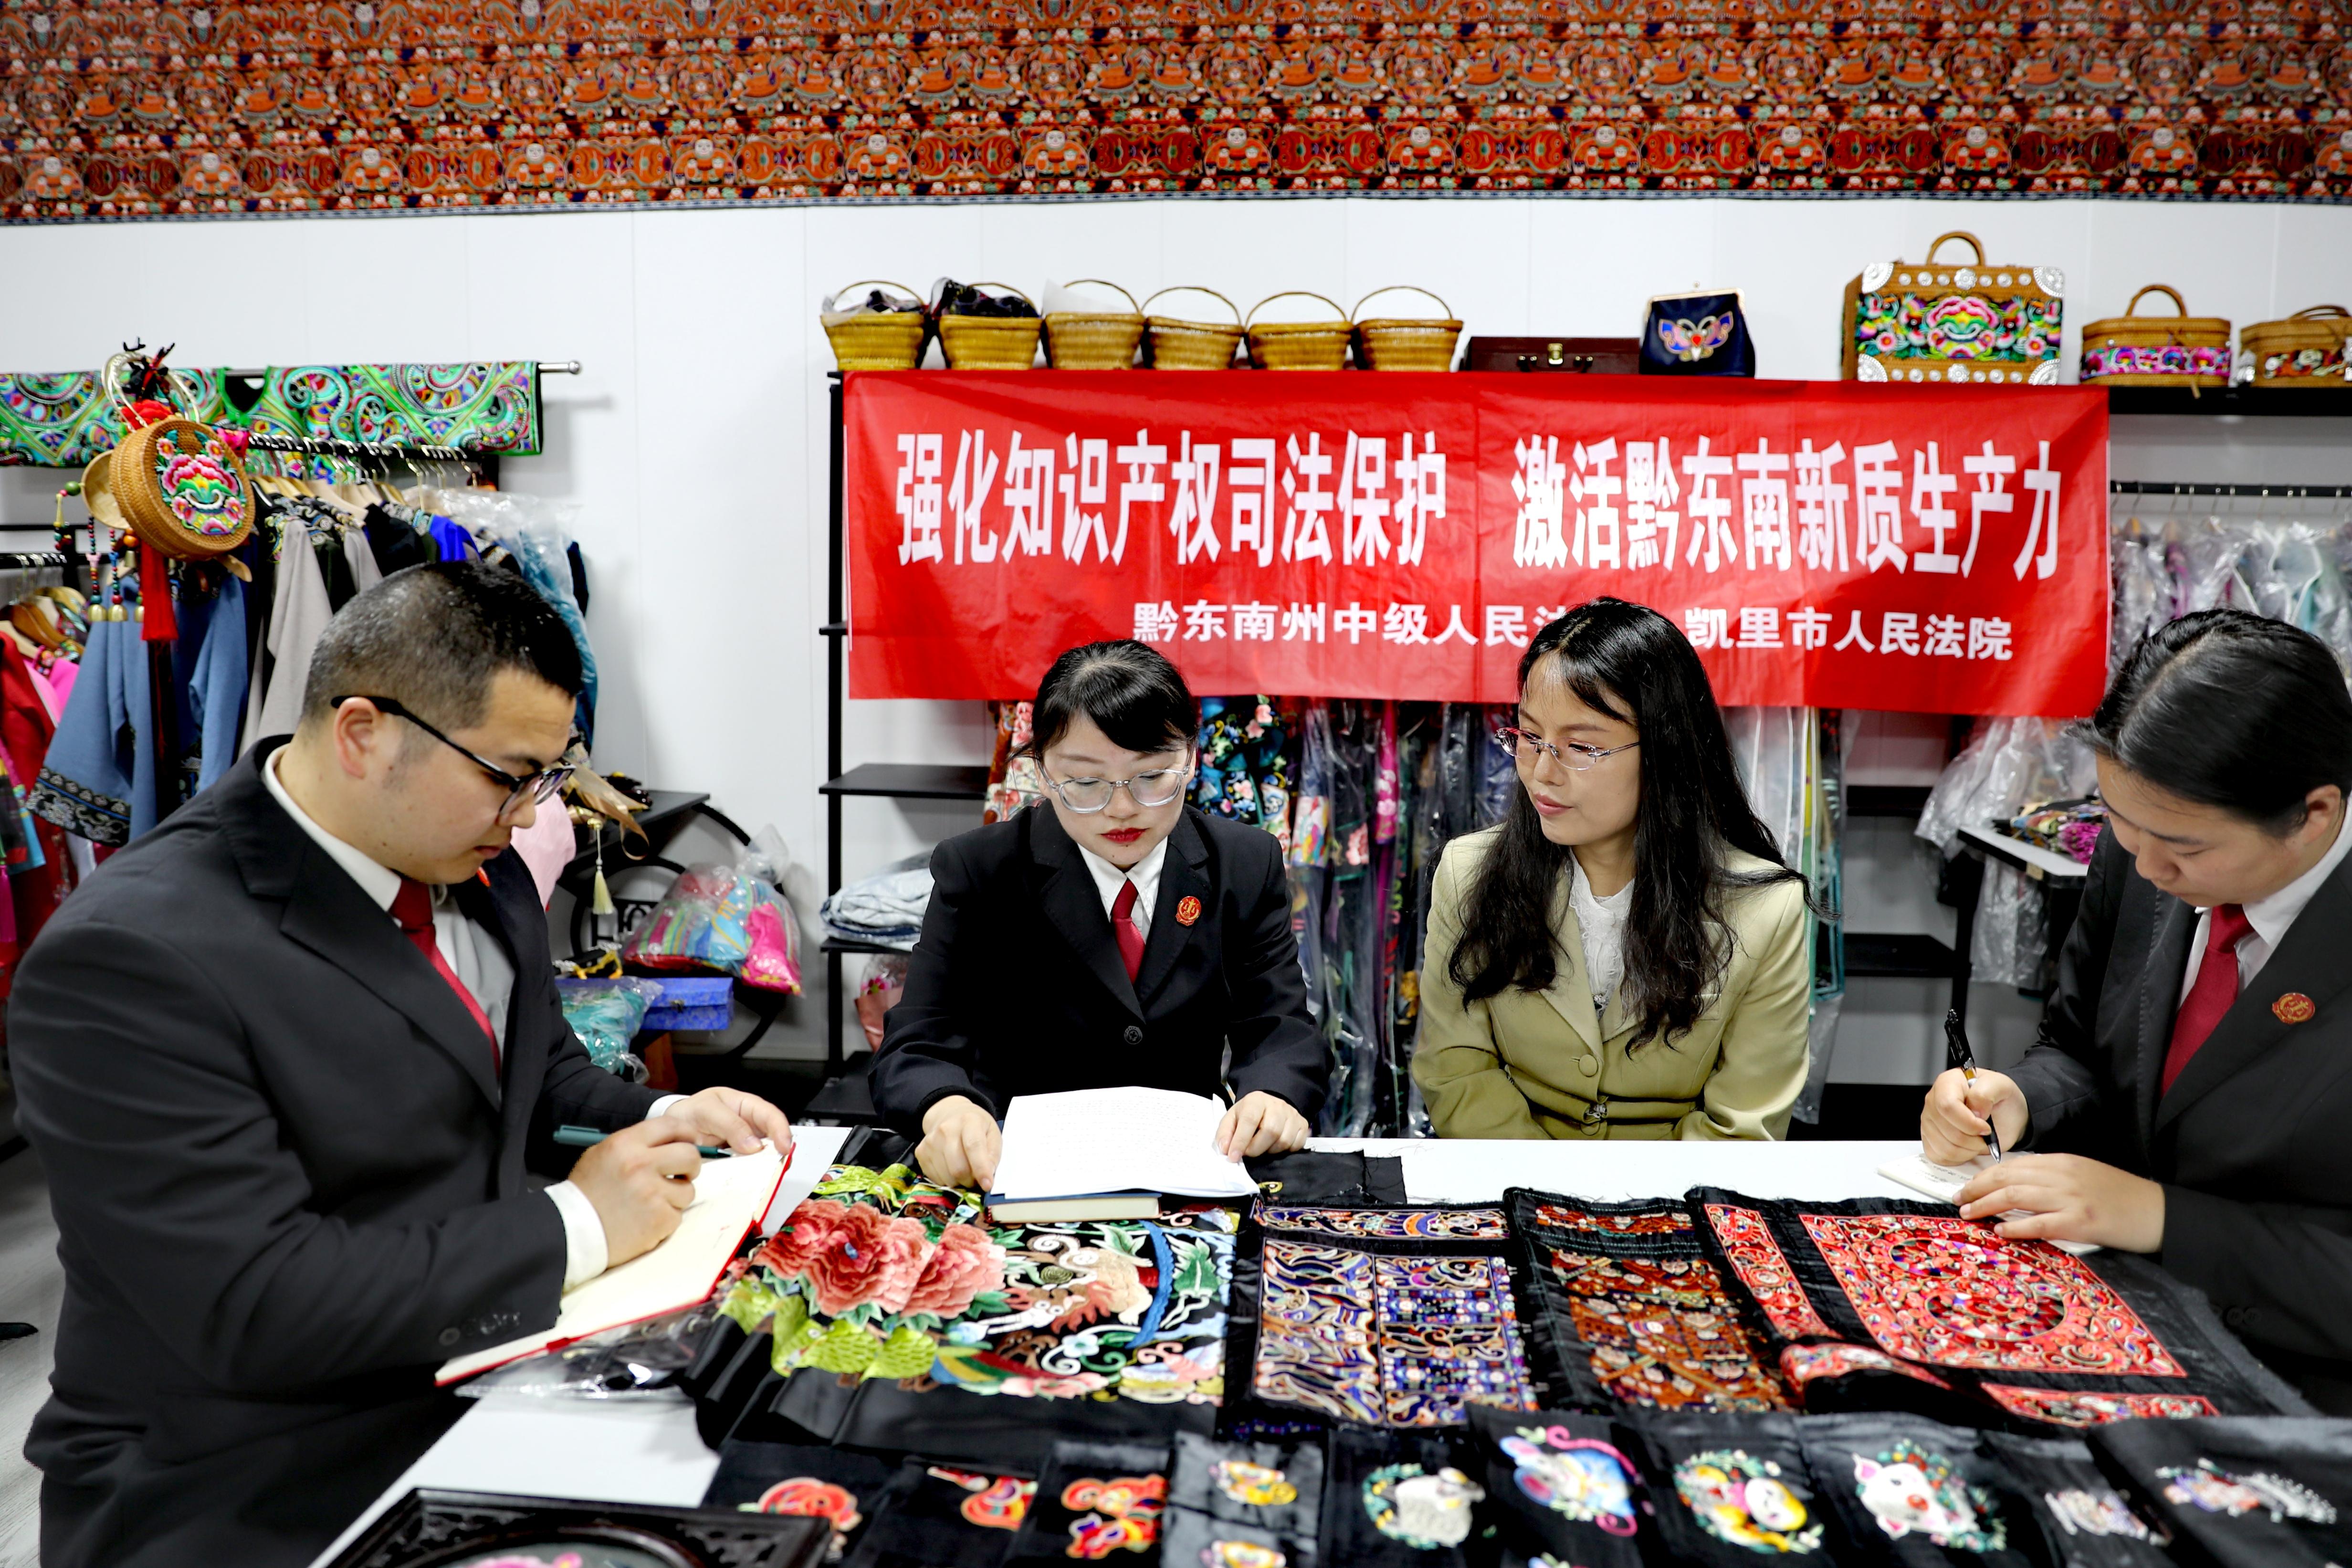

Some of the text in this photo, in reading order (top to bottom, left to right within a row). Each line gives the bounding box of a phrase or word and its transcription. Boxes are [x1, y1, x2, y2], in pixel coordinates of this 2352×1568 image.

[895, 428, 2061, 580] 强化知识产权司法保护 激活黔东南新质生产力
[1684, 606, 2013, 661] 凯里市人民法院
